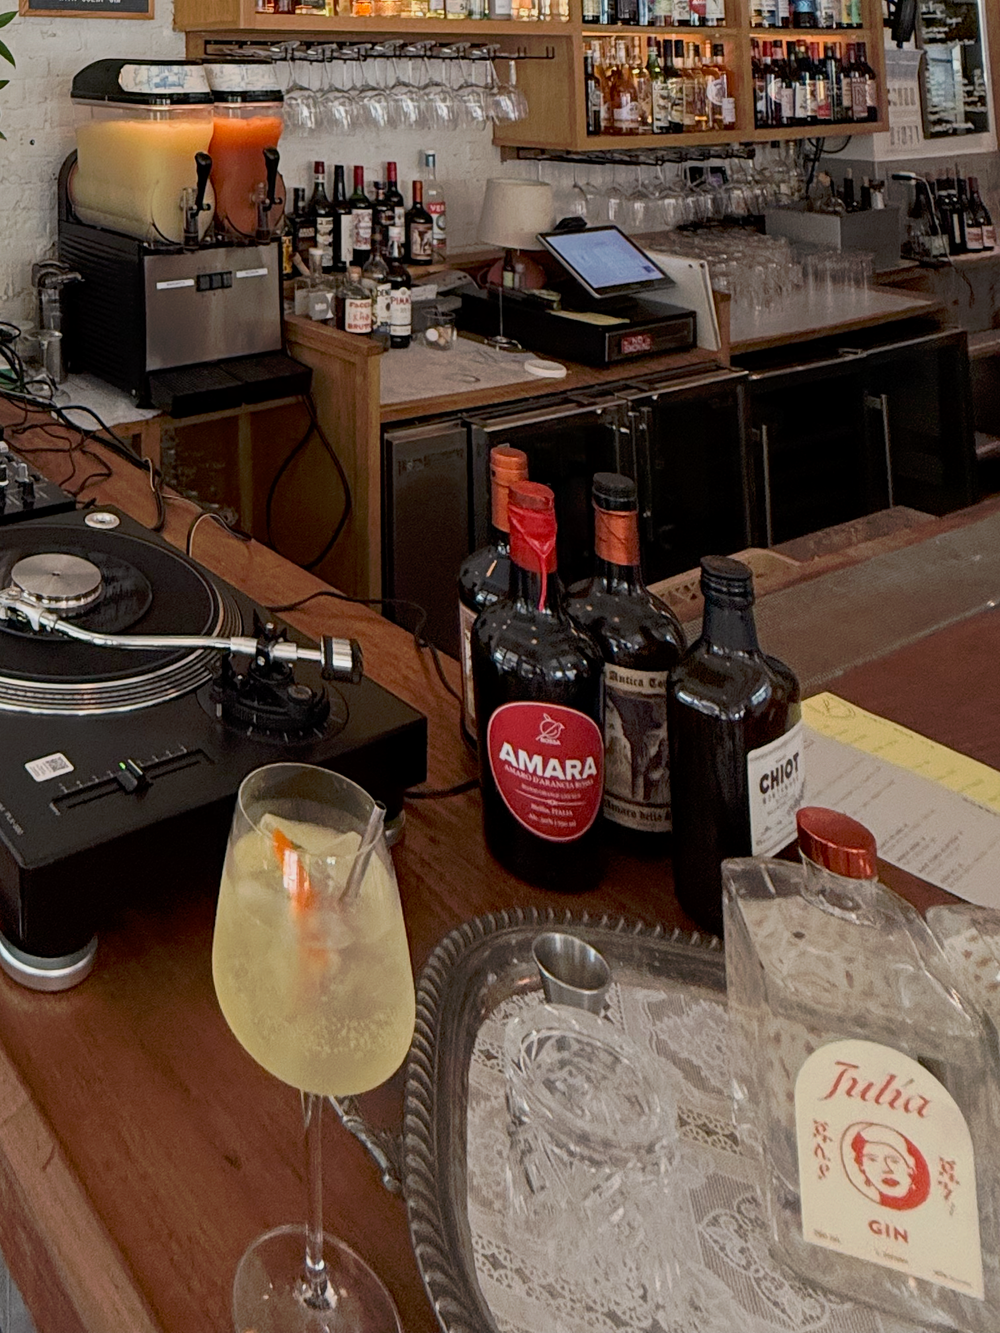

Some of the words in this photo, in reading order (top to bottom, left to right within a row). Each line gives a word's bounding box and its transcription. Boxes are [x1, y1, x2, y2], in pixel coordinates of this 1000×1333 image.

[499, 741, 598, 781] AMARA
[504, 764, 532, 782] AMARO
[868, 1219, 908, 1244] GIN
